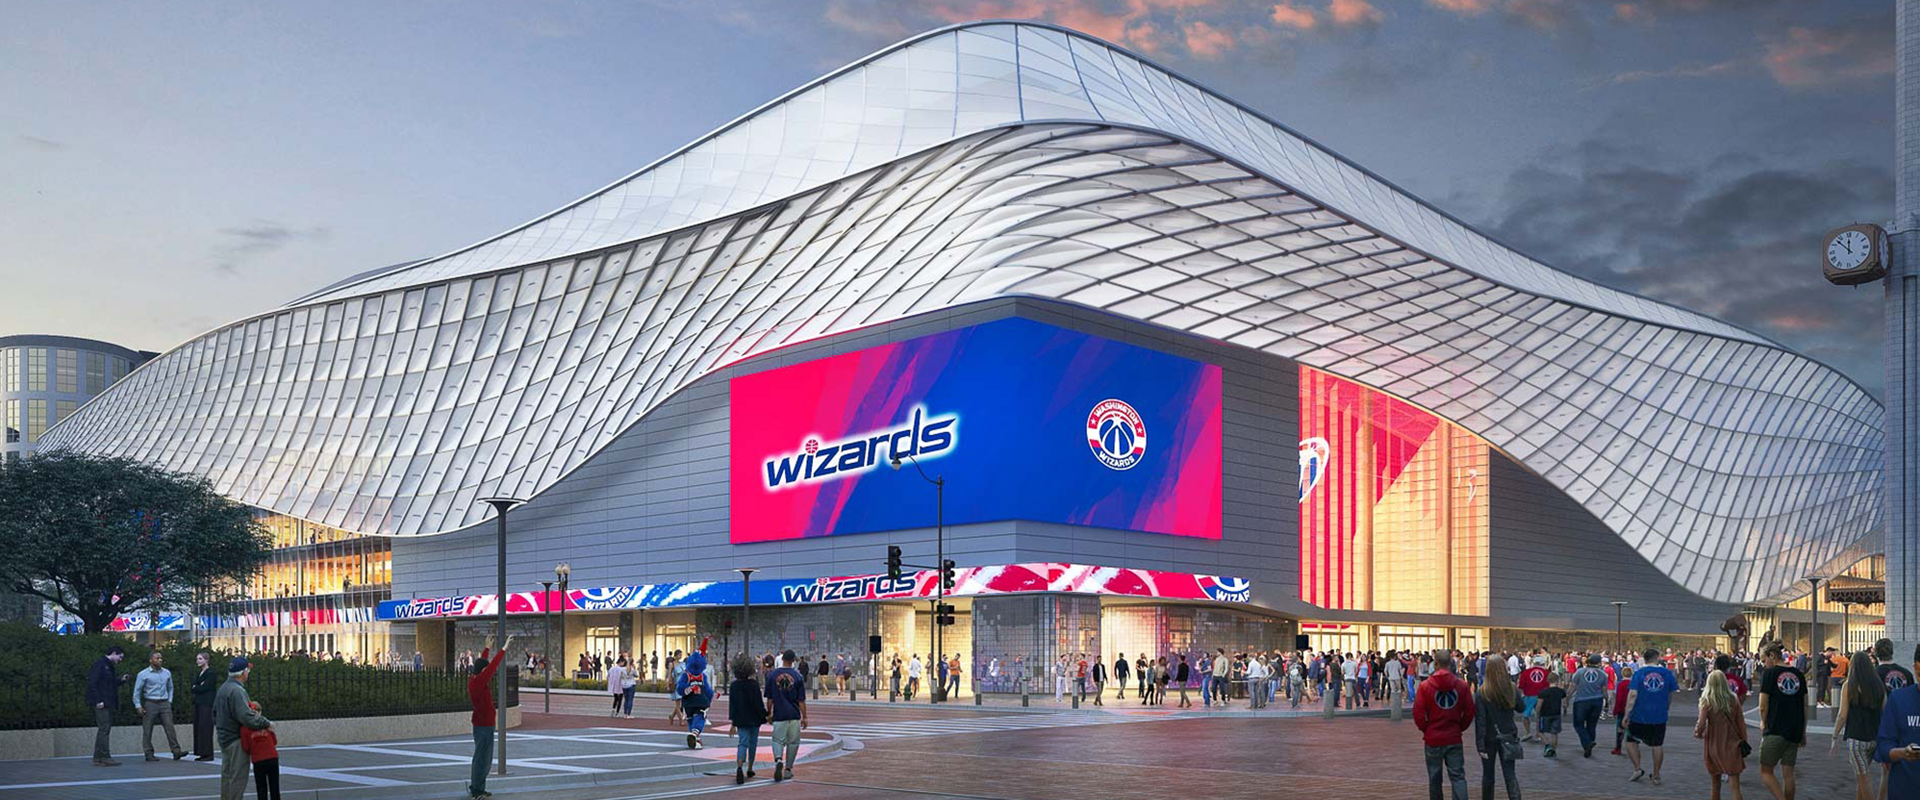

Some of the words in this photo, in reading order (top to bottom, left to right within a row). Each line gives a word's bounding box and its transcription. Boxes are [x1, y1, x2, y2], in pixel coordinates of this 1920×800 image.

[1093, 401, 1140, 425] WASHINGTON
[766, 407, 957, 487] wizards
[1099, 451, 1136, 468] WIZARDS
[584, 586, 631, 610] WIZARDS
[784, 571, 920, 602] wizards
[395, 596, 464, 618] wizards
